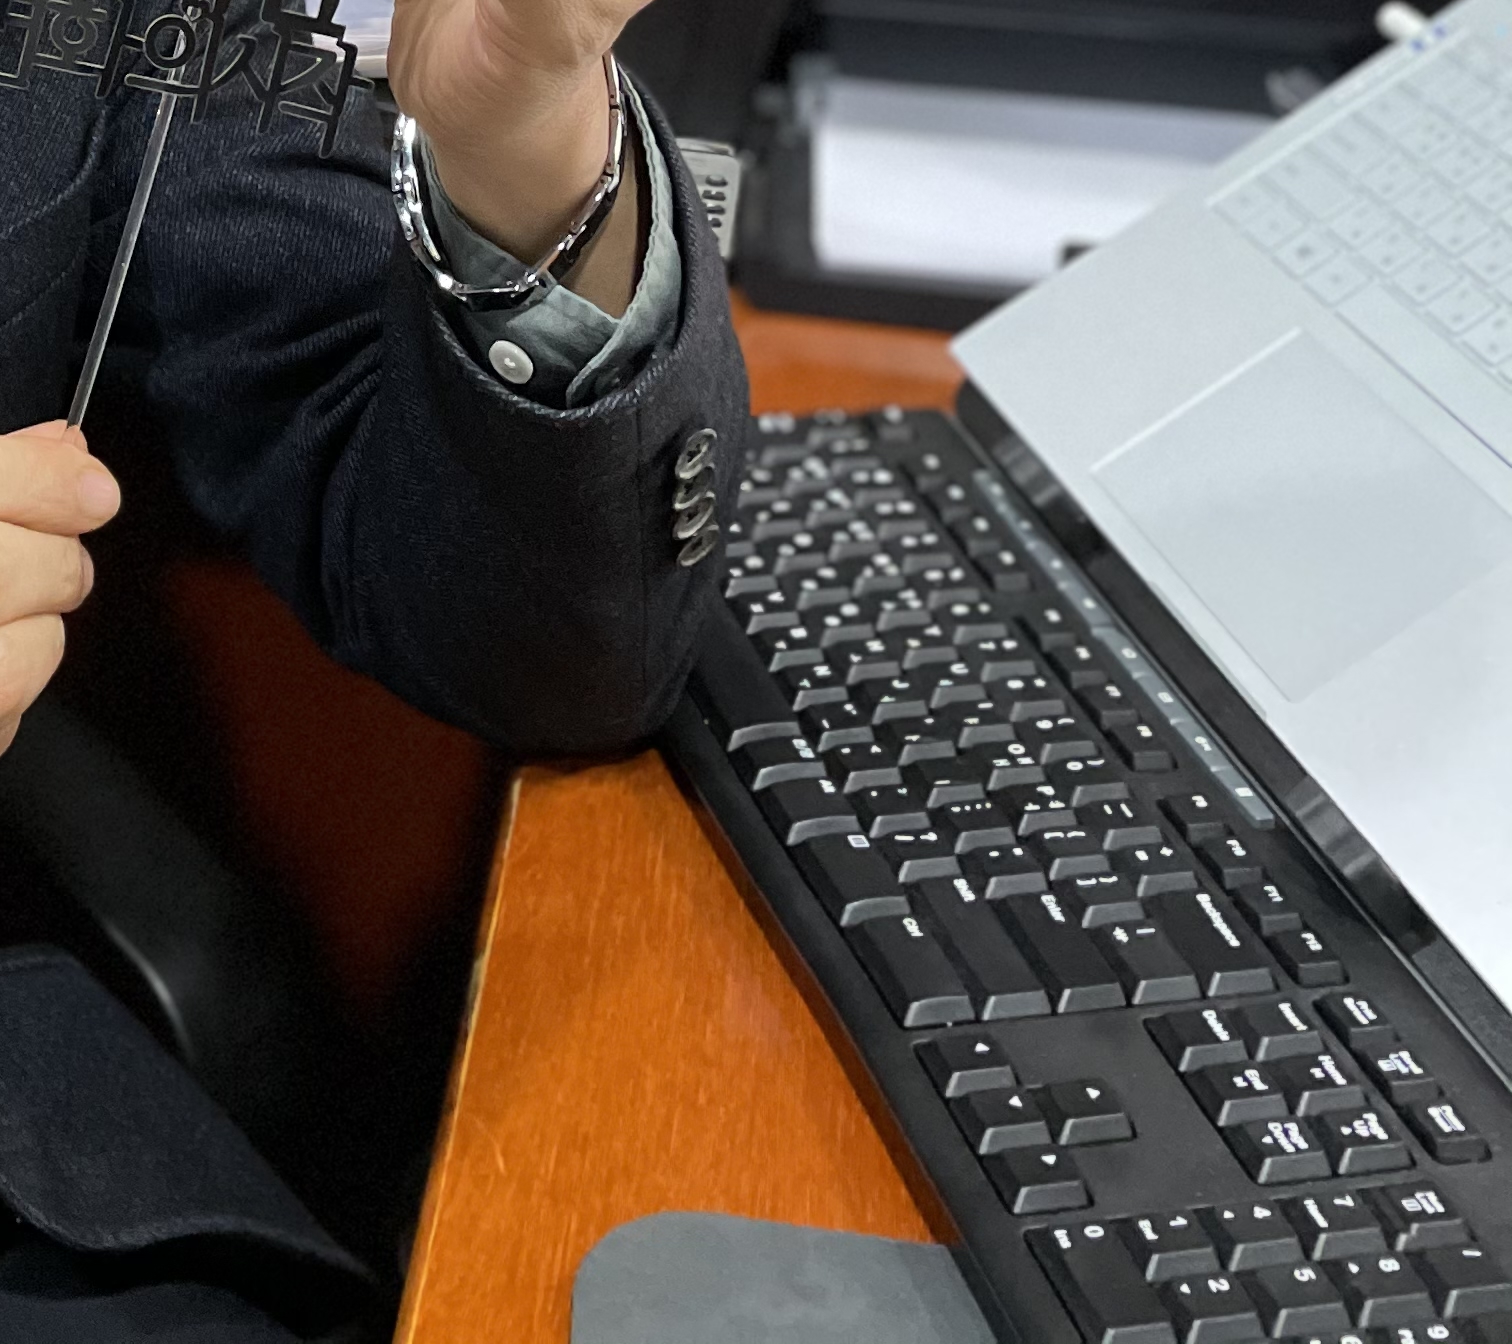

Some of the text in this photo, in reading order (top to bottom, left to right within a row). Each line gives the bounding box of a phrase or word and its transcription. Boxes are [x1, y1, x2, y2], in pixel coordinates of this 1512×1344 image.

[1226, 840, 1246, 856] F10
[954, 879, 975, 902] Shift
[1264, 886, 1283, 901] F11
[1041, 895, 1065, 922] Enter
[903, 918, 923, 936] Ctrl
[1196, 894, 1240, 946] Backspace
[1301, 933, 1322, 951] F12
[1203, 1010, 1230, 1041] Delete
[1279, 1003, 1307, 1031] Insert
[1244, 1069, 1269, 1091] End
[1318, 1055, 1347, 1085] Home
[1283, 1122, 1310, 1150] Page
[1353, 1120, 1370, 1137] Up
[1362, 1112, 1389, 1140] Page
[1268, 1121, 1296, 1153] Down
[1254, 1206, 1271, 1219] 4
[1054, 1229, 1071, 1249] Ins
[1294, 1267, 1316, 1281] 5
[1379, 1258, 1400, 1272] 8
[1208, 1279, 1230, 1292] 2
[1427, 1325, 1449, 1339] 9
